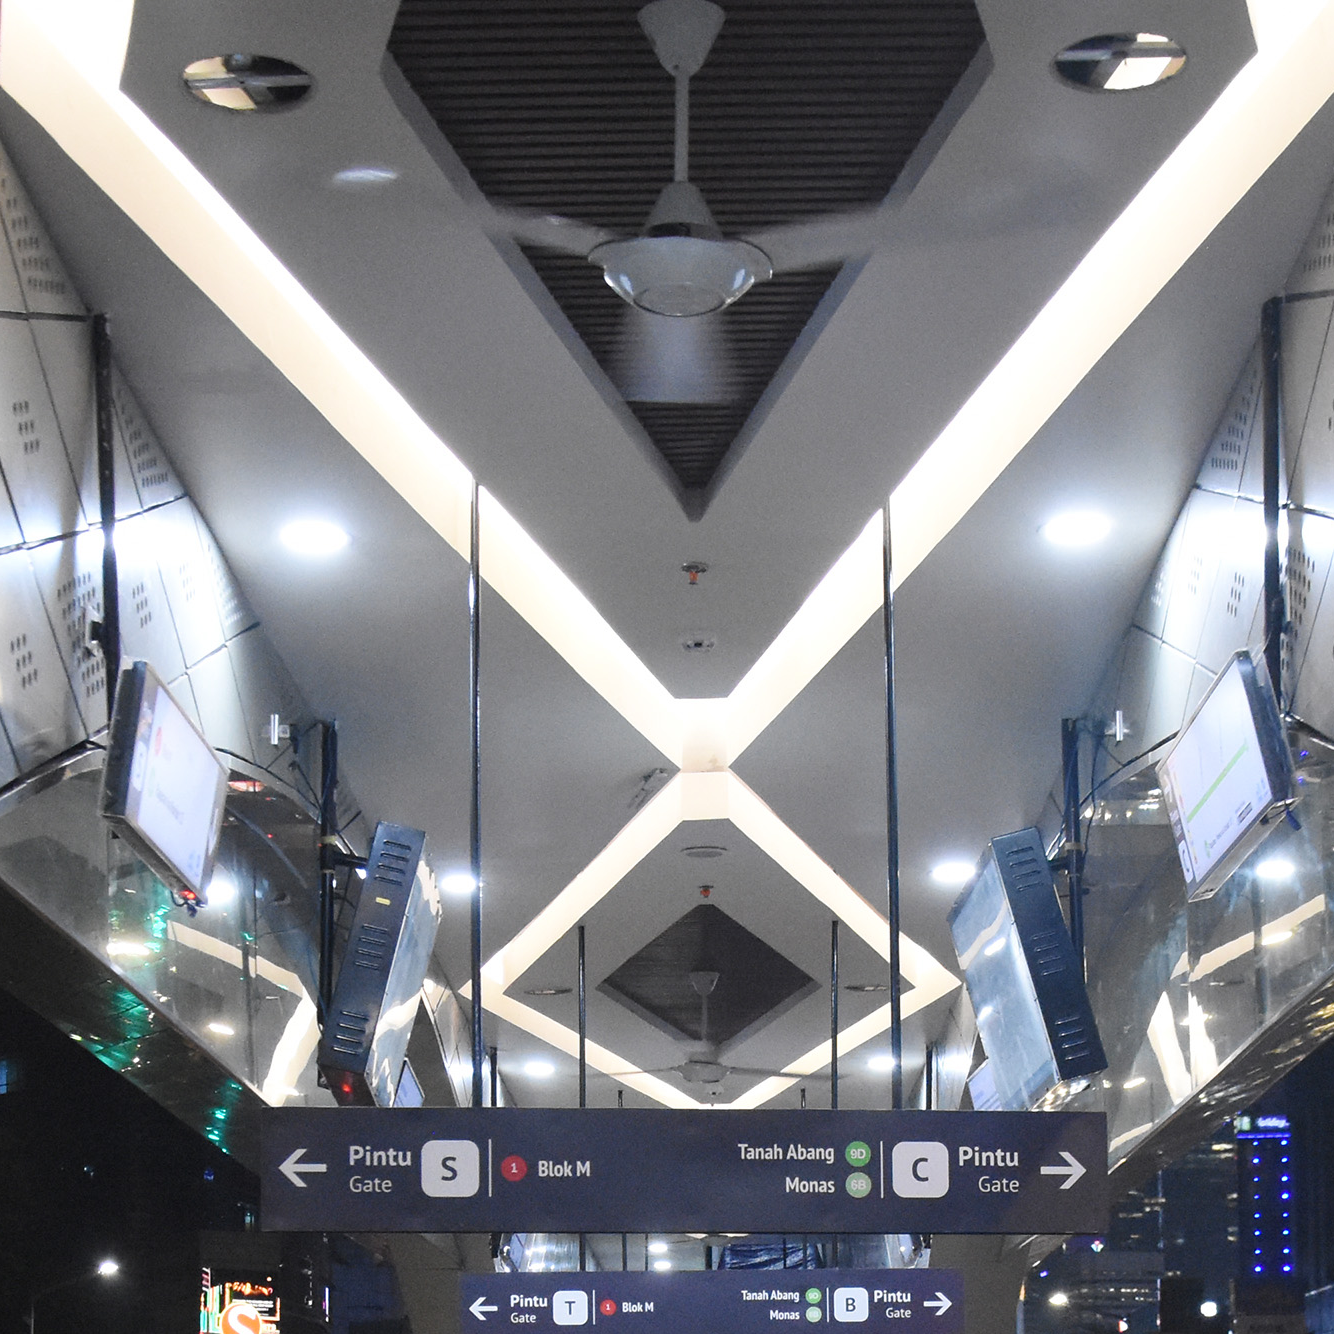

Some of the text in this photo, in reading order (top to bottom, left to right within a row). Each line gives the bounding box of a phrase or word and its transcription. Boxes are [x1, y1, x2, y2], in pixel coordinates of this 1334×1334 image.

[349, 1145, 412, 1167] Pintu
[738, 1144, 866, 1163] Tanah Abang 9D
[958, 1146, 1019, 1167] Pintu
[441, 1155, 458, 1182] S
[510, 1162, 518, 1174] 1
[538, 1160, 591, 1177] Blok M
[911, 1157, 929, 1182] C
[349, 1175, 392, 1193] Gate
[785, 1177, 867, 1193] Monas 6B
[978, 1175, 1019, 1193] Gate
[510, 1294, 548, 1308] Pintu
[741, 1290, 769, 1301] Tanah
[770, 1290, 800, 1303] Abang
[873, 1290, 911, 1303] Pintu
[564, 1300, 576, 1316] T
[622, 1302, 654, 1313] Blok M
[845, 1297, 856, 1313] B
[886, 1307, 911, 1318] Gate
[510, 1312, 537, 1323] Gate
[770, 1309, 800, 1321] Monas
